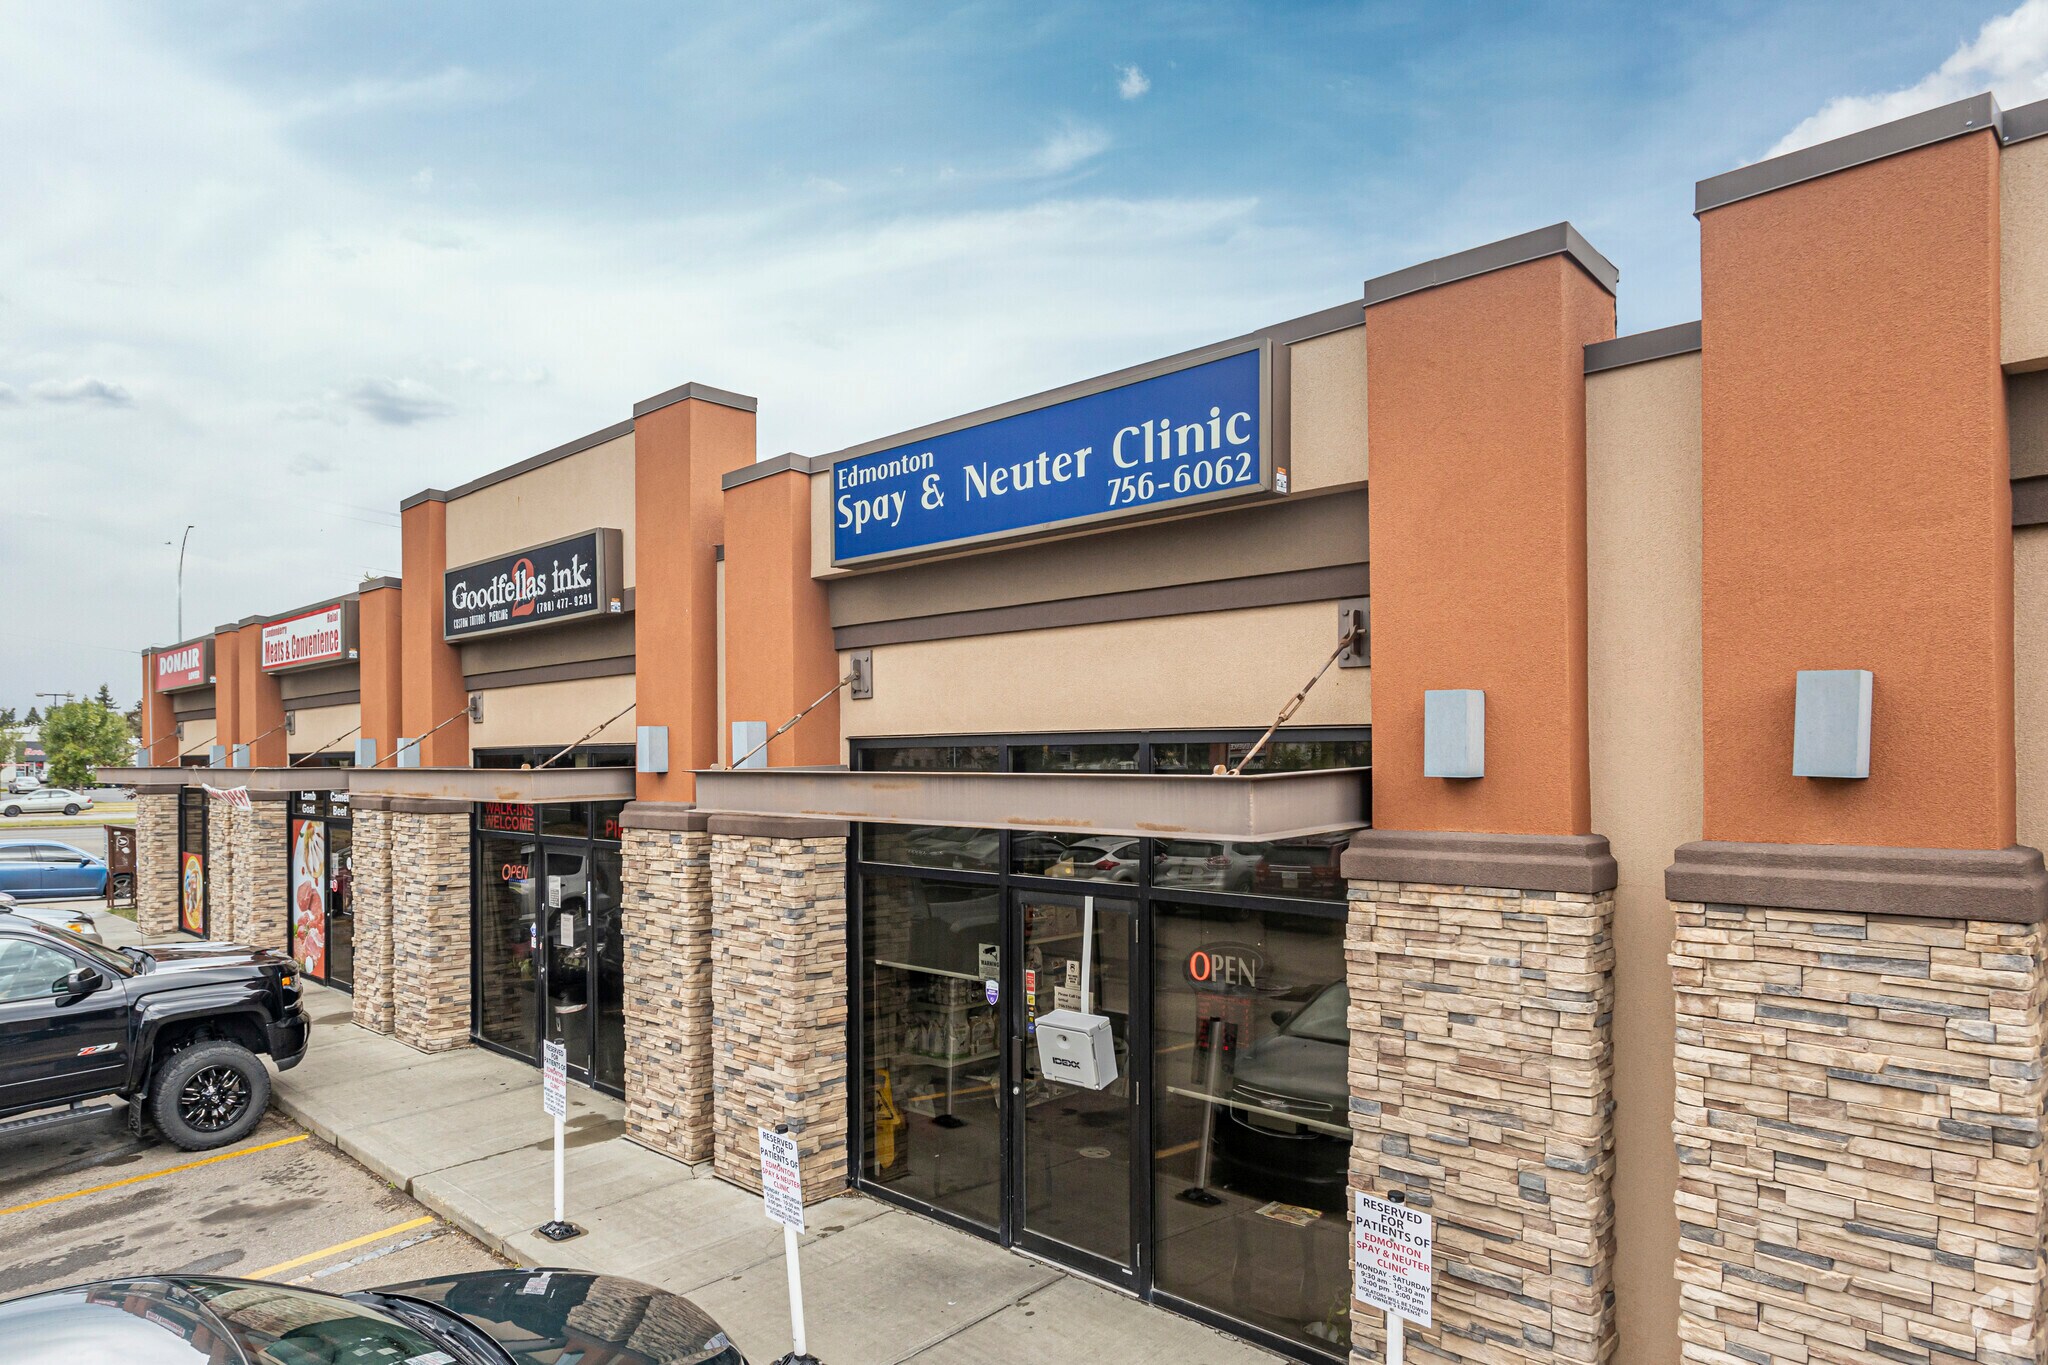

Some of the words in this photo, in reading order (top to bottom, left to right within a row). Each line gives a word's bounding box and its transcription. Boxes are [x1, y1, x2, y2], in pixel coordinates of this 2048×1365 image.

[837, 488, 906, 533] Spay
[921, 473, 945, 510] &
[963, 447, 1092, 501] Neuter
[1112, 406, 1251, 469] Clinic
[838, 450, 933, 490] Edmonton
[1107, 452, 1252, 505] 756-6062
[452, 569, 546, 610] Goodfellas
[536, 600, 555, 614] (780)
[264, 640, 284, 664] Meats
[286, 640, 290, 661] &
[292, 629, 339, 659] Convenience
[160, 648, 199, 676] DONAIR
[301, 790, 316, 801] Lamb
[302, 804, 316, 814] Goat
[333, 805, 347, 816] Beef
[485, 815, 534, 831] WELCOME
[502, 864, 528, 881] OPEN
[1190, 951, 1255, 988] OPEN
[1053, 1057, 1080, 1069] IDEXX
[762, 1131, 793, 1150] RESERVED
[773, 1144, 785, 1155] FOR
[761, 1147, 789, 1166] PATIENTS
[790, 1160, 798, 1169] OF
[765, 1160, 795, 1178] EDMONTON
[762, 1168, 775, 1178] SPAY
[780, 1175, 800, 1188] NEUTER
[773, 1180, 790, 1193] CLINIC
[1363, 1198, 1422, 1224] RESERVED
[1381, 1214, 1403, 1229] FOR
[1356, 1216, 1411, 1242] PATIENTS
[1414, 1236, 1430, 1248] OF
[1356, 1241, 1380, 1254] SPAY
[1383, 1250, 1389, 1258] &
[1392, 1252, 1430, 1272] NEUTER
[1364, 1232, 1421, 1258] EDMONTON
[1356, 1261, 1387, 1277] MONDAY
[1392, 1275, 1430, 1293] SATURDAY
[1377, 1258, 1408, 1276] CLINIC
[1360, 1270, 1375, 1281] 9:30
[1393, 1282, 1413, 1295] 10:30
[1414, 1291, 1426, 1299] am
[1363, 1277, 1377, 1288] 3:00
[1378, 1285, 1390, 1293] pm
[1395, 1290, 1410, 1301] 5:00
[1412, 1297, 1424, 1306] pm
[1358, 1285, 1387, 1300] VIOLATORS
[1388, 1296, 1400, 1304] WILL
[1409, 1303, 1428, 1315] TOWED
[1373, 1294, 1397, 1309] OWNER'S
[1397, 1305, 1421, 1317] EXPENSE
